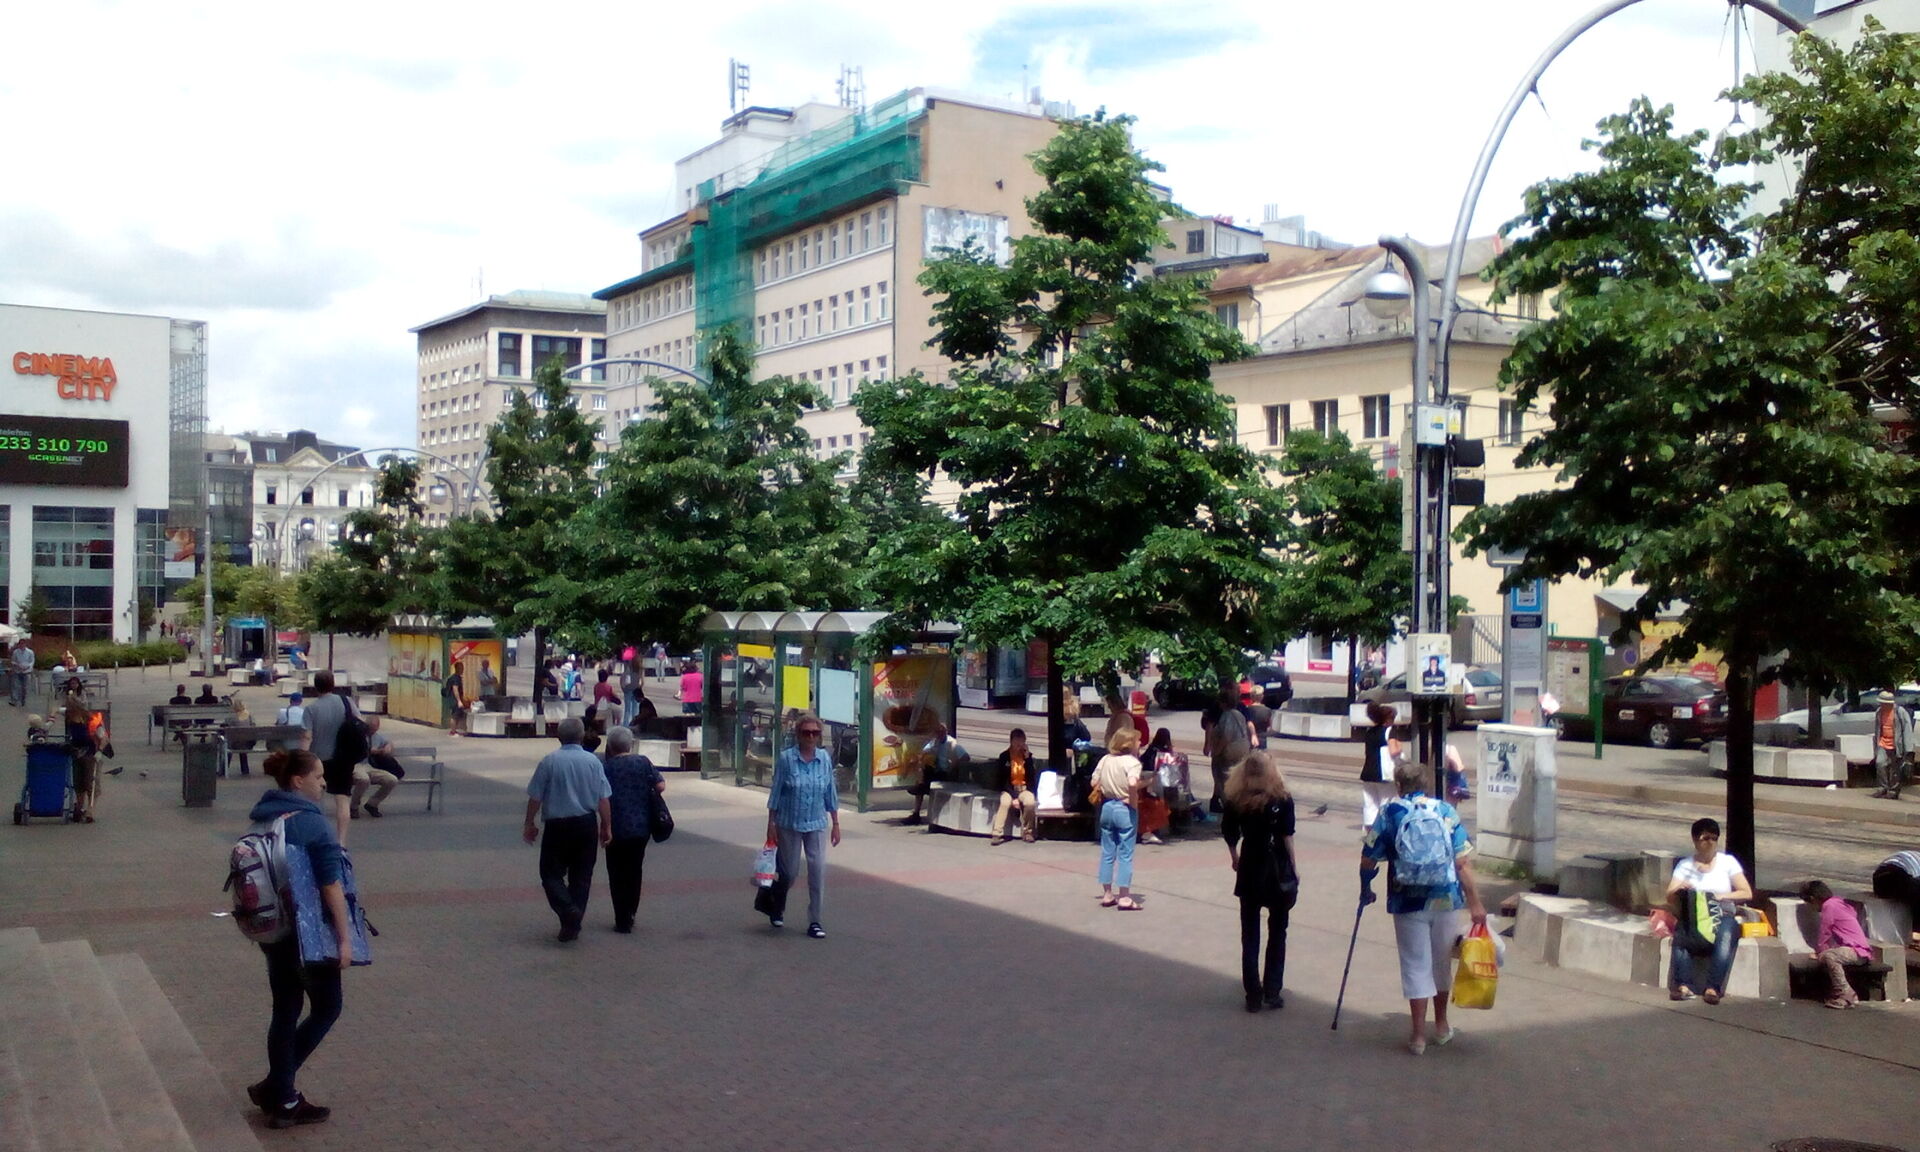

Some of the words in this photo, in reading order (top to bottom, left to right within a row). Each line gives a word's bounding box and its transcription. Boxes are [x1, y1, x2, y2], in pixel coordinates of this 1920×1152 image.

[13, 352, 116, 380] CINEMA
[57, 377, 115, 401] CITY
[0, 437, 31, 450] 233
[37, 438, 71, 452] 310
[75, 439, 108, 453] 790
